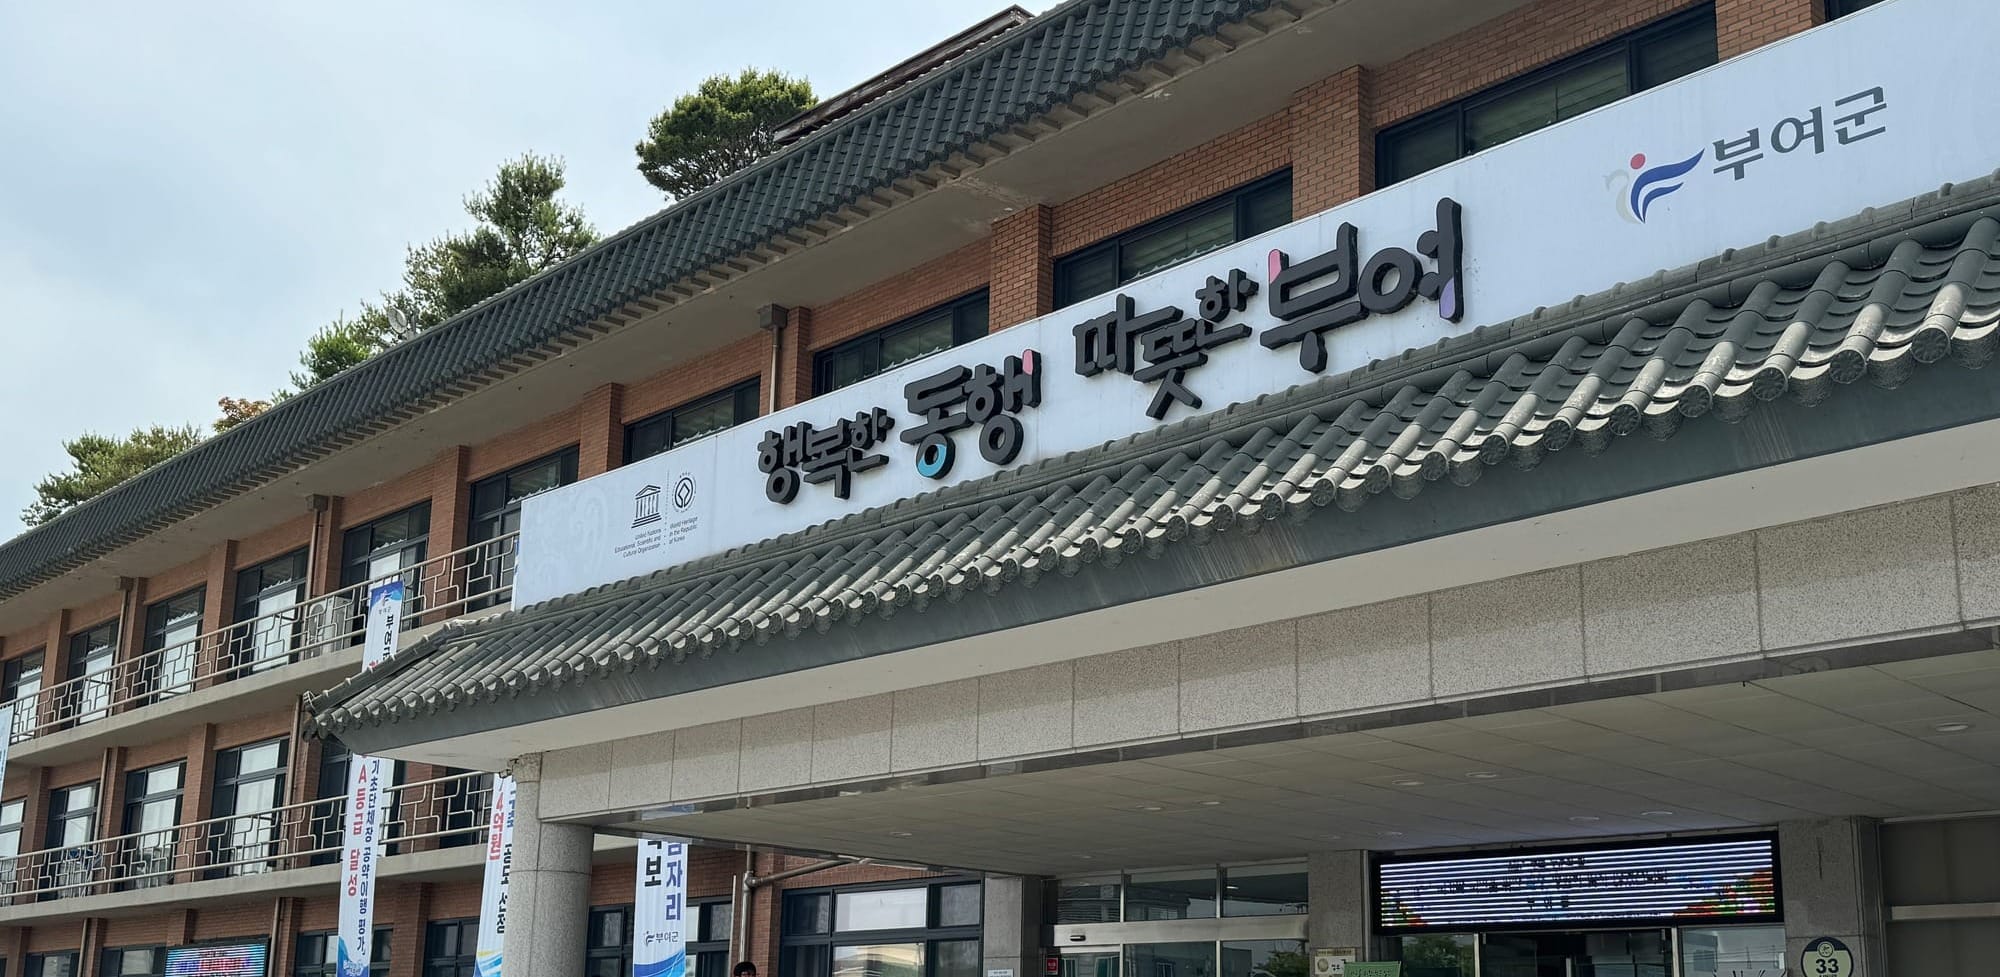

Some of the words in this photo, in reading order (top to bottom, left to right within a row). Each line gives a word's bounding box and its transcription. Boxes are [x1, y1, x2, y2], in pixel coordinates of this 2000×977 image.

[1712, 86, 1887, 181] 부여군
[757, 407, 895, 504] 행복한
[900, 349, 1042, 479] 동행
[1073, 268, 1259, 420] 따뜻한
[1260, 197, 1464, 373] 부여
[348, 849, 360, 896] 달성
[656, 931, 679, 943] 부여군
[1816, 958, 1839, 974] 33
